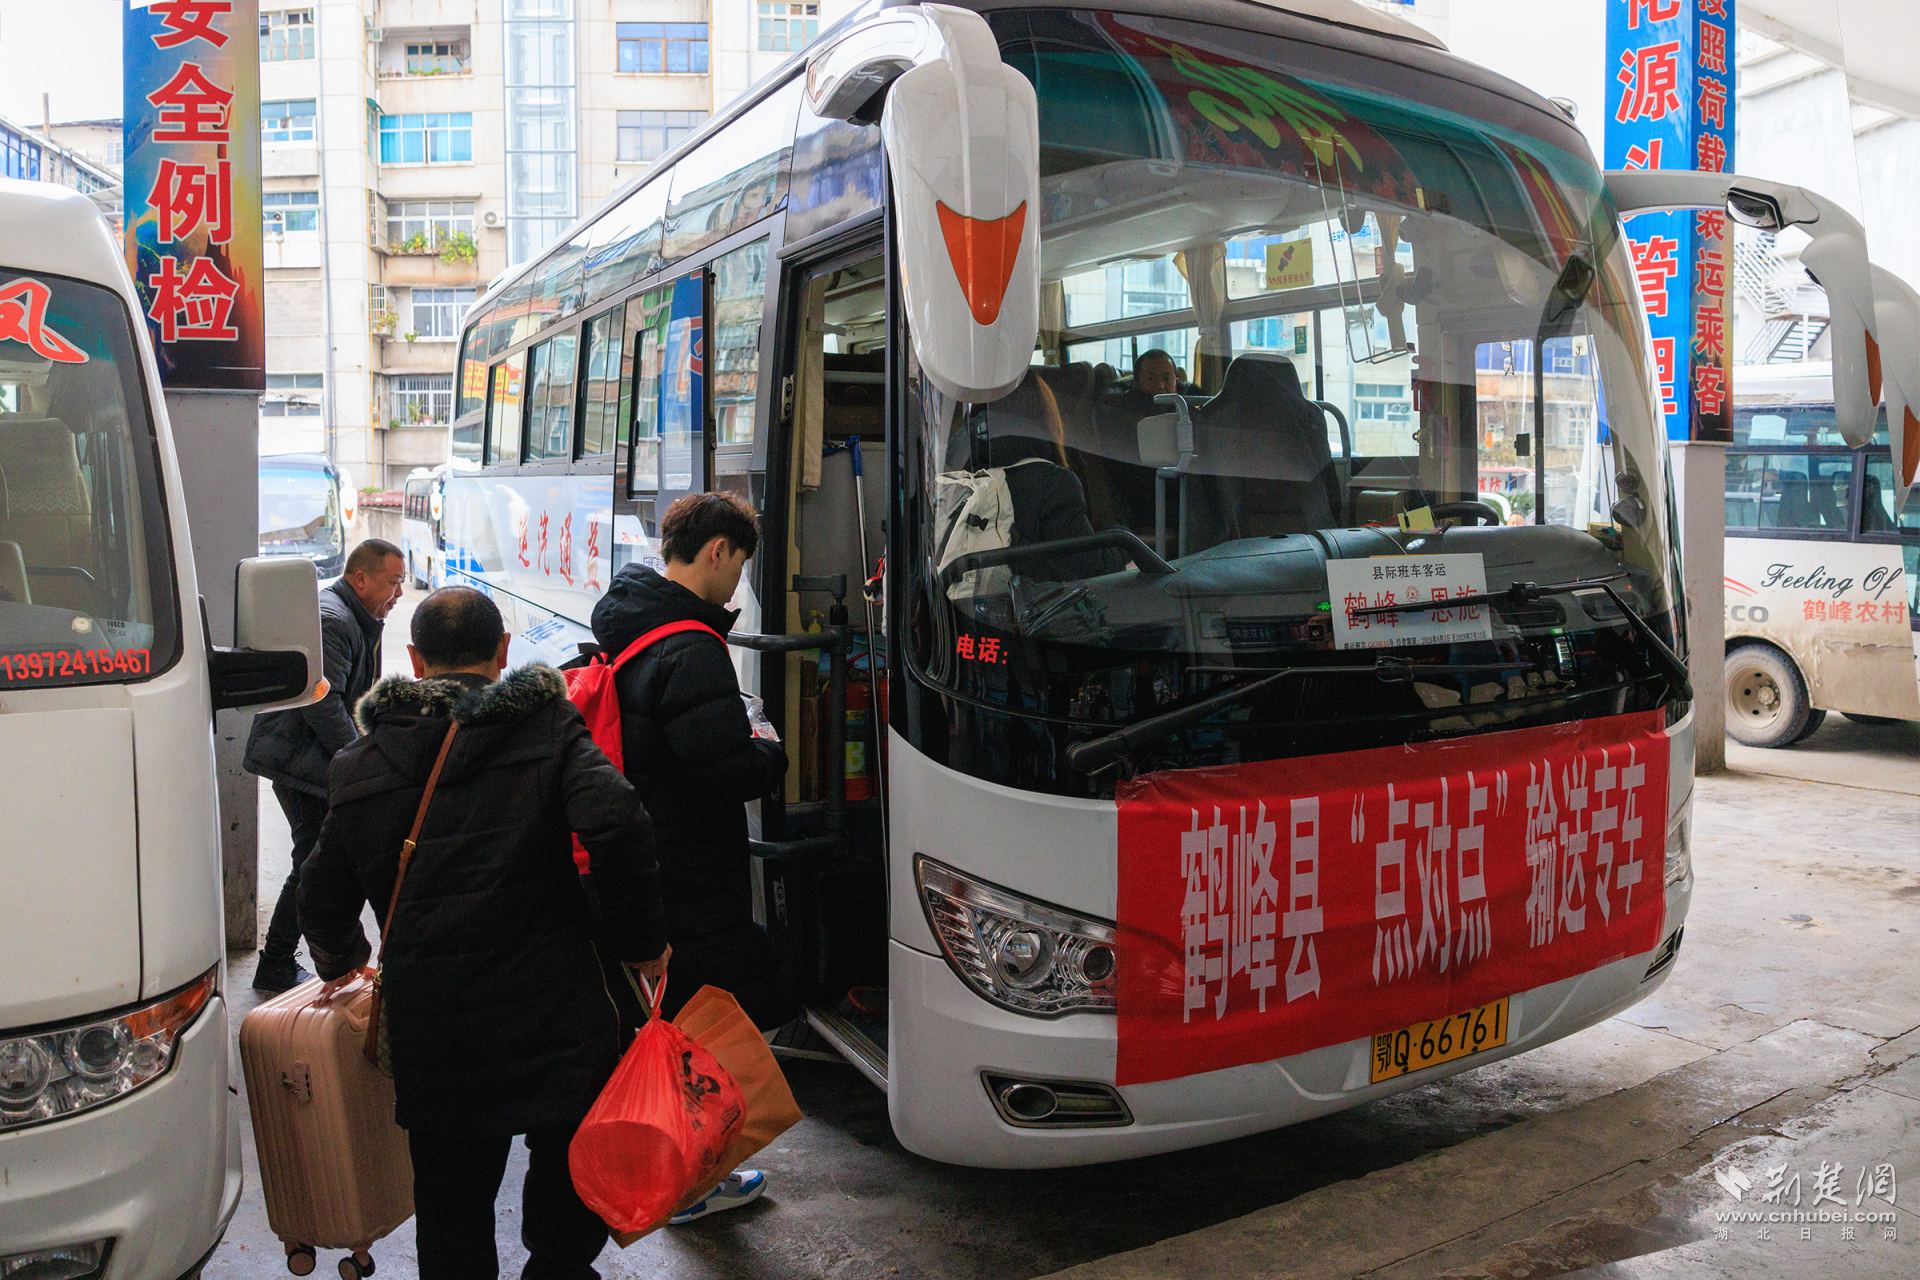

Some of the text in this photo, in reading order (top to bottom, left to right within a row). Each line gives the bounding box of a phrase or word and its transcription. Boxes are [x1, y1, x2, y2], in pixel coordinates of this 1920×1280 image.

[1372, 563, 1447, 581] 县际班车客运
[1760, 563, 1904, 600] Feeling Of
[1724, 604, 1770, 624] CO
[1802, 599, 1907, 625] 鹤峰农村
[0, 648, 151, 681] 13972415467
